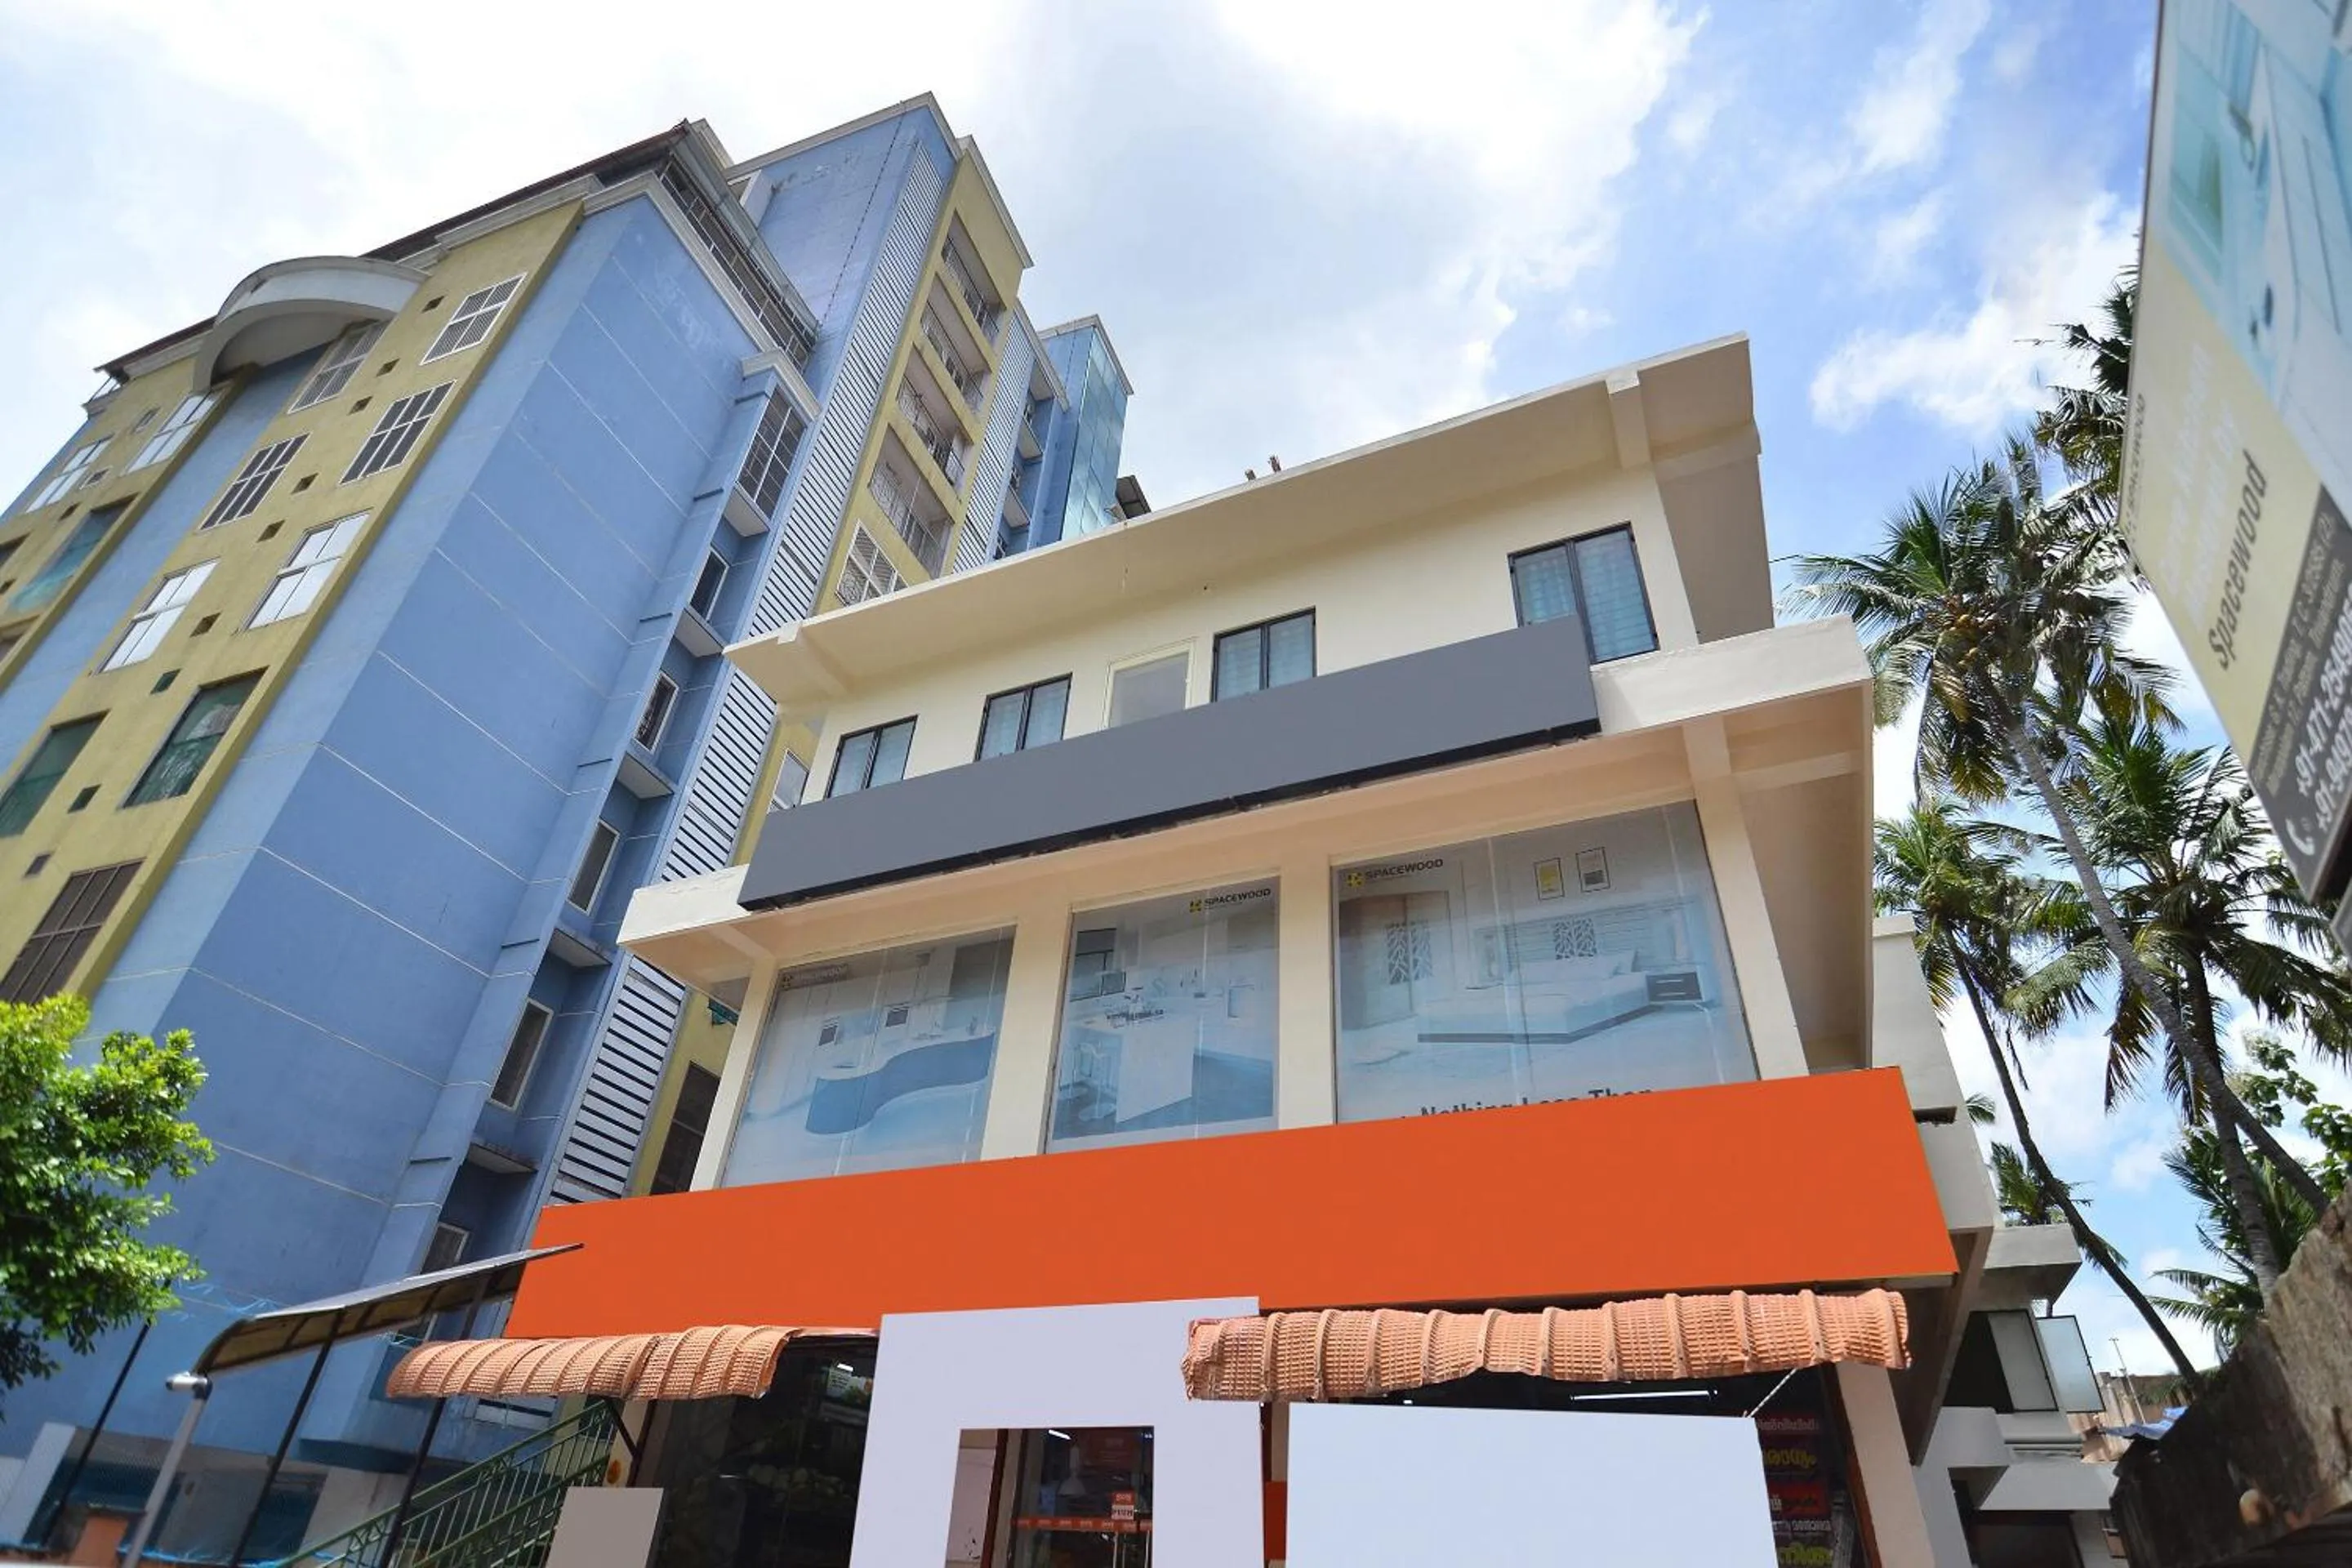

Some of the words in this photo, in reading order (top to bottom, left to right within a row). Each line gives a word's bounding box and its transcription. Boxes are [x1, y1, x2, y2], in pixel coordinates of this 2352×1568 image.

[2207, 448, 2267, 670] Spacewood
[1365, 858, 1444, 879] SPACEWOOD
[1205, 888, 1272, 904] SPACEWOOD
